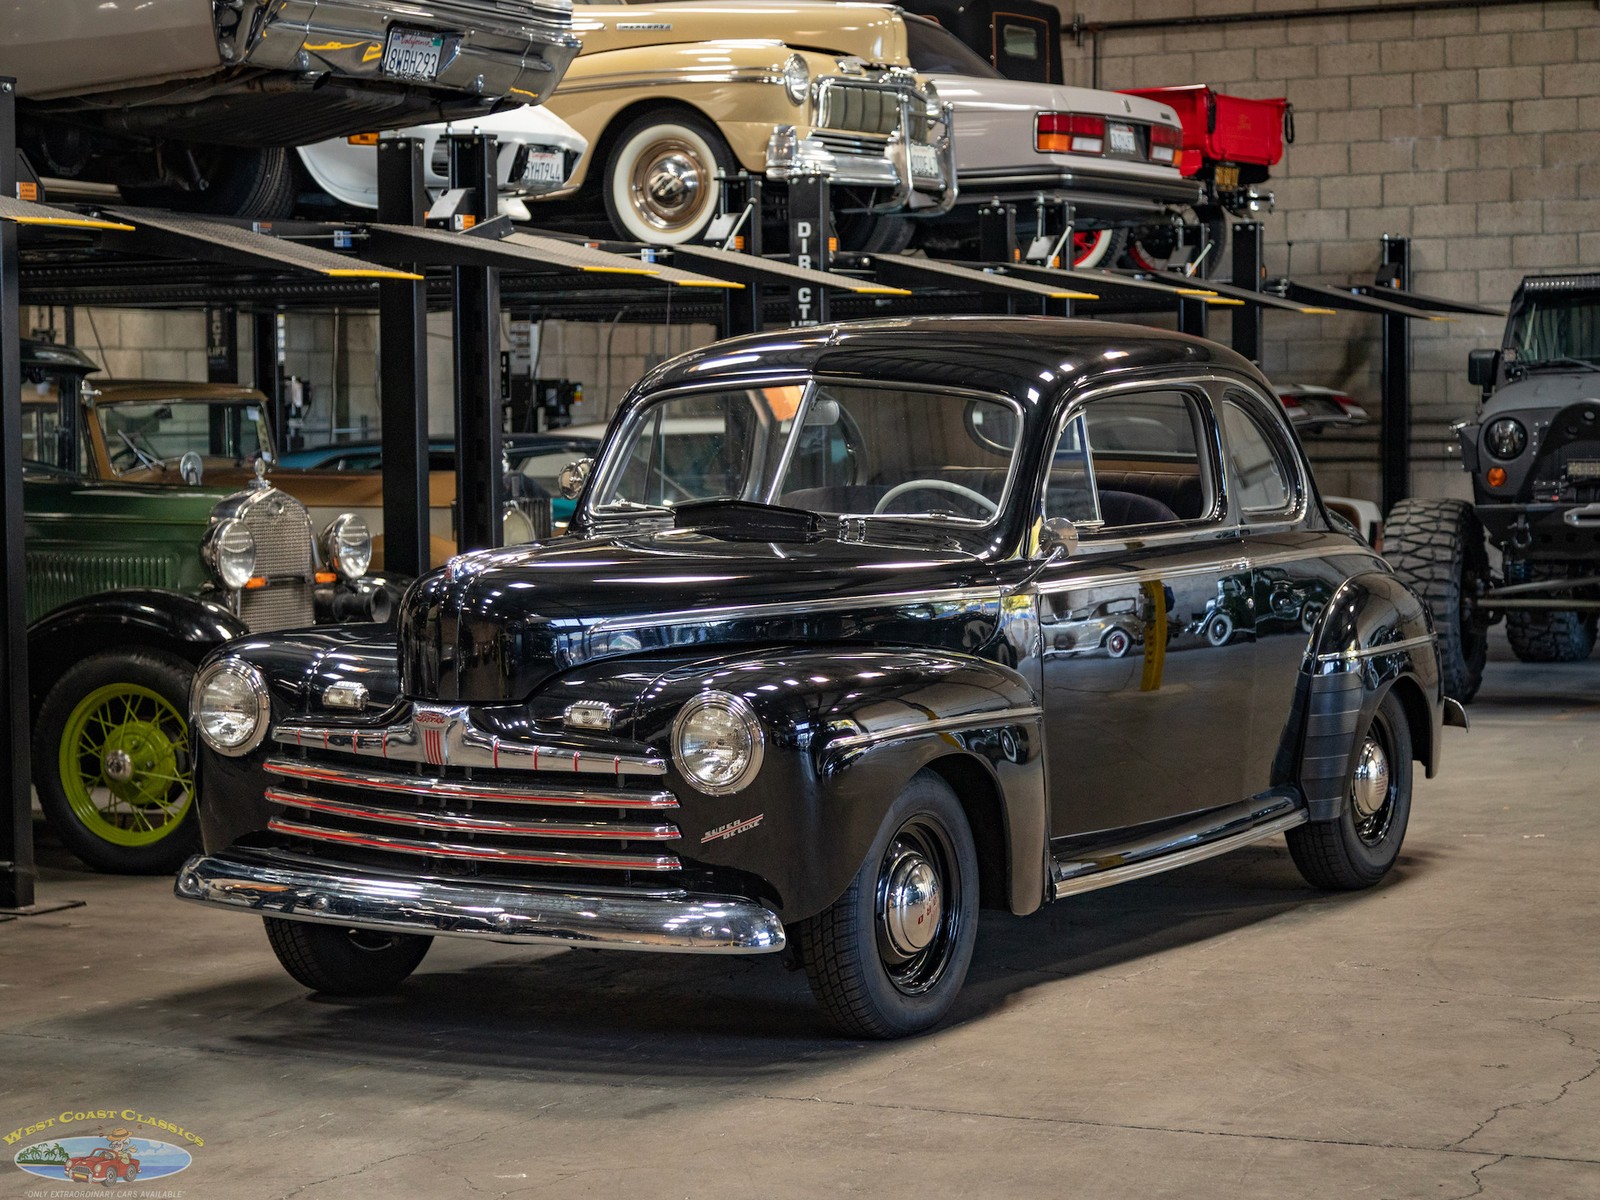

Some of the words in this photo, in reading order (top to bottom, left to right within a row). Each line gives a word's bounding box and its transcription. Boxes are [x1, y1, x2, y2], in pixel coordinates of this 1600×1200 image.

[389, 48, 437, 74] 8WBH293
[797, 221, 812, 320] DIRCT
[704, 819, 740, 836] SUPER
